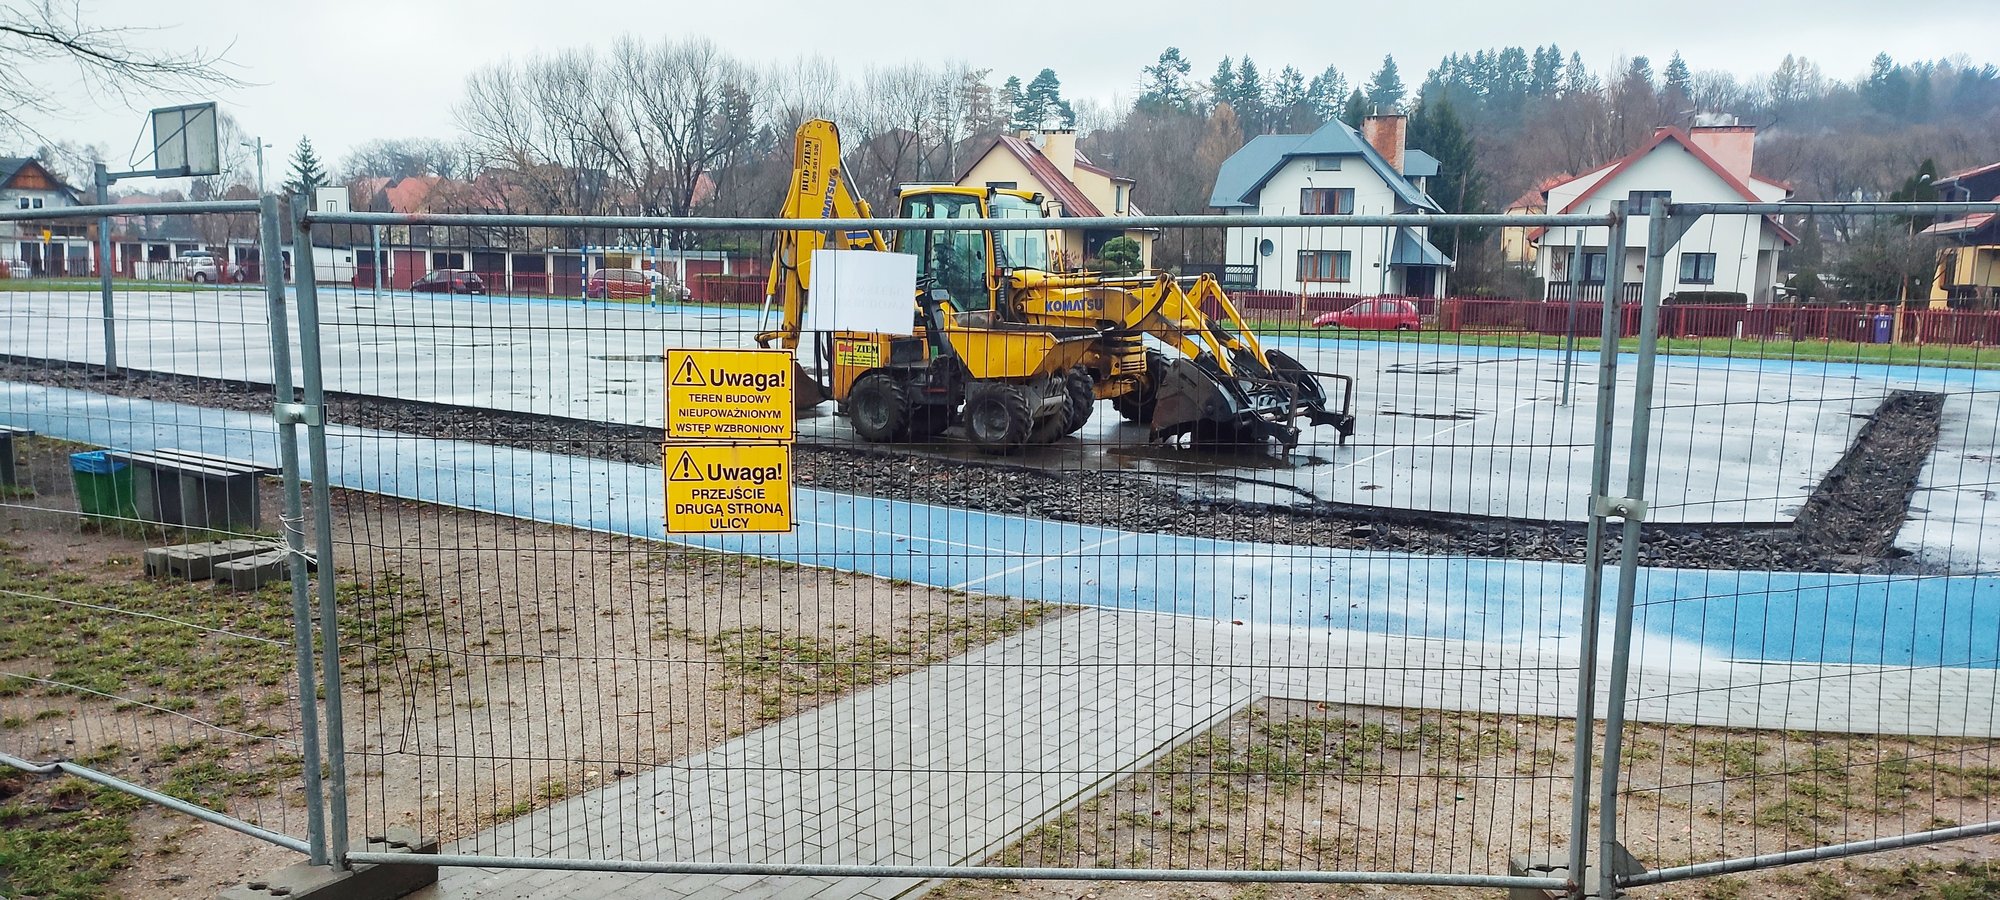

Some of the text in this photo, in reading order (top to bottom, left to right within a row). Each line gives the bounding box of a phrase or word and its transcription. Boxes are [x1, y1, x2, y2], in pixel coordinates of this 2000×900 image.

[802, 140, 812, 191] BUD-ZIEM
[1046, 298, 1103, 312] KOMATSU
[710, 369, 786, 392] Uwaga!
[689, 394, 771, 404] TEREN BUDOWY
[678, 407, 782, 419] NIEUPOWAŻNIONYM
[676, 423, 784, 435] WSTĘP WZBRONIONY
[707, 463, 782, 485] Uwaga!
[691, 486, 765, 500] PRZEJŚCIE
[675, 503, 783, 517] DRUGĄ STRONĄ
[710, 518, 750, 529] ULICY
